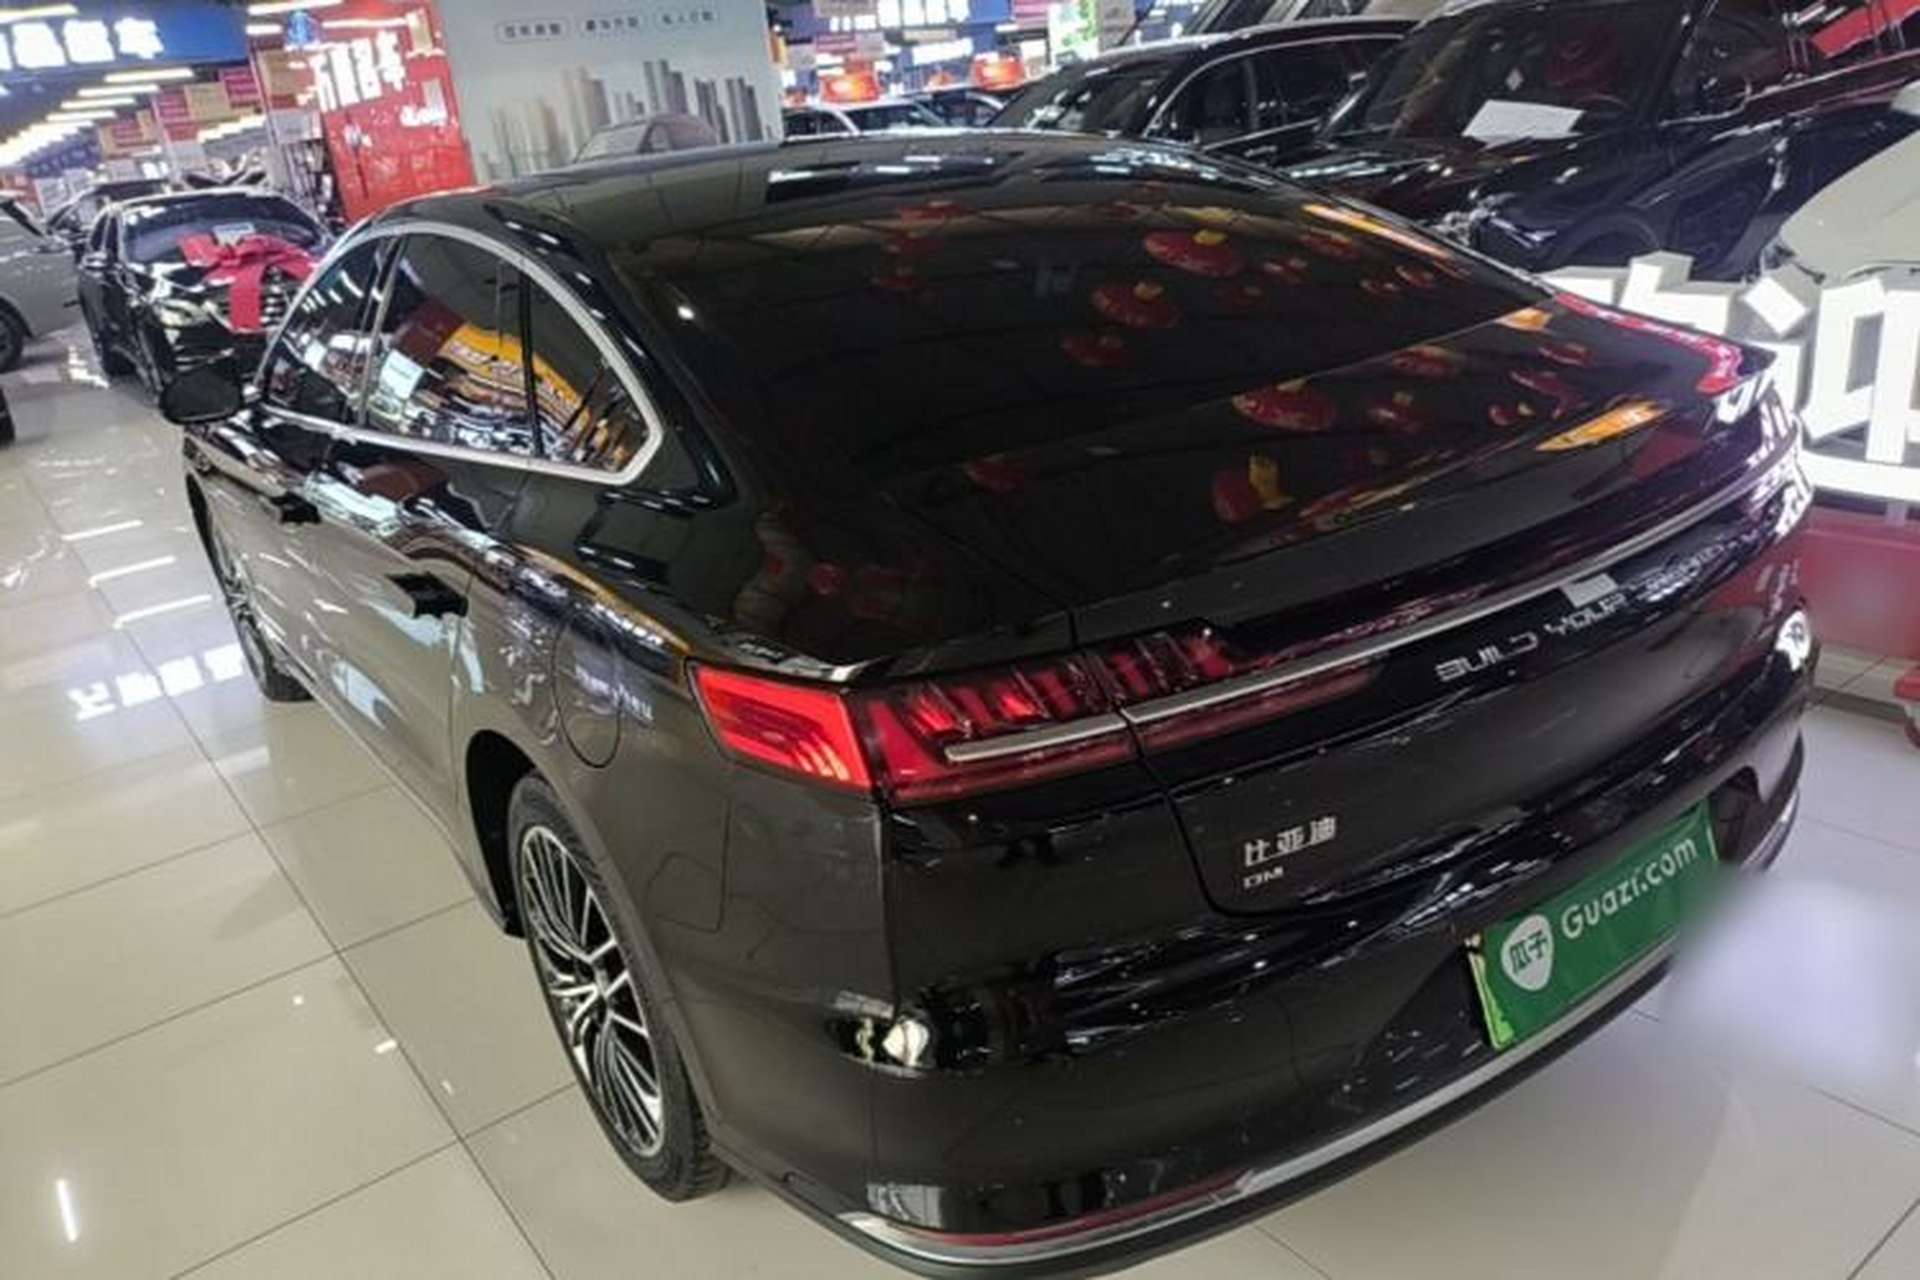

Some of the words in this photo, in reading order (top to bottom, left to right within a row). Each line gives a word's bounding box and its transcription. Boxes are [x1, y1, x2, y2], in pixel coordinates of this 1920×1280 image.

[1434, 631, 1540, 682] BUILD
[1543, 593, 1628, 635] YOUR
[1244, 815, 1337, 868] 比亚迪
[1243, 866, 1284, 889] DM
